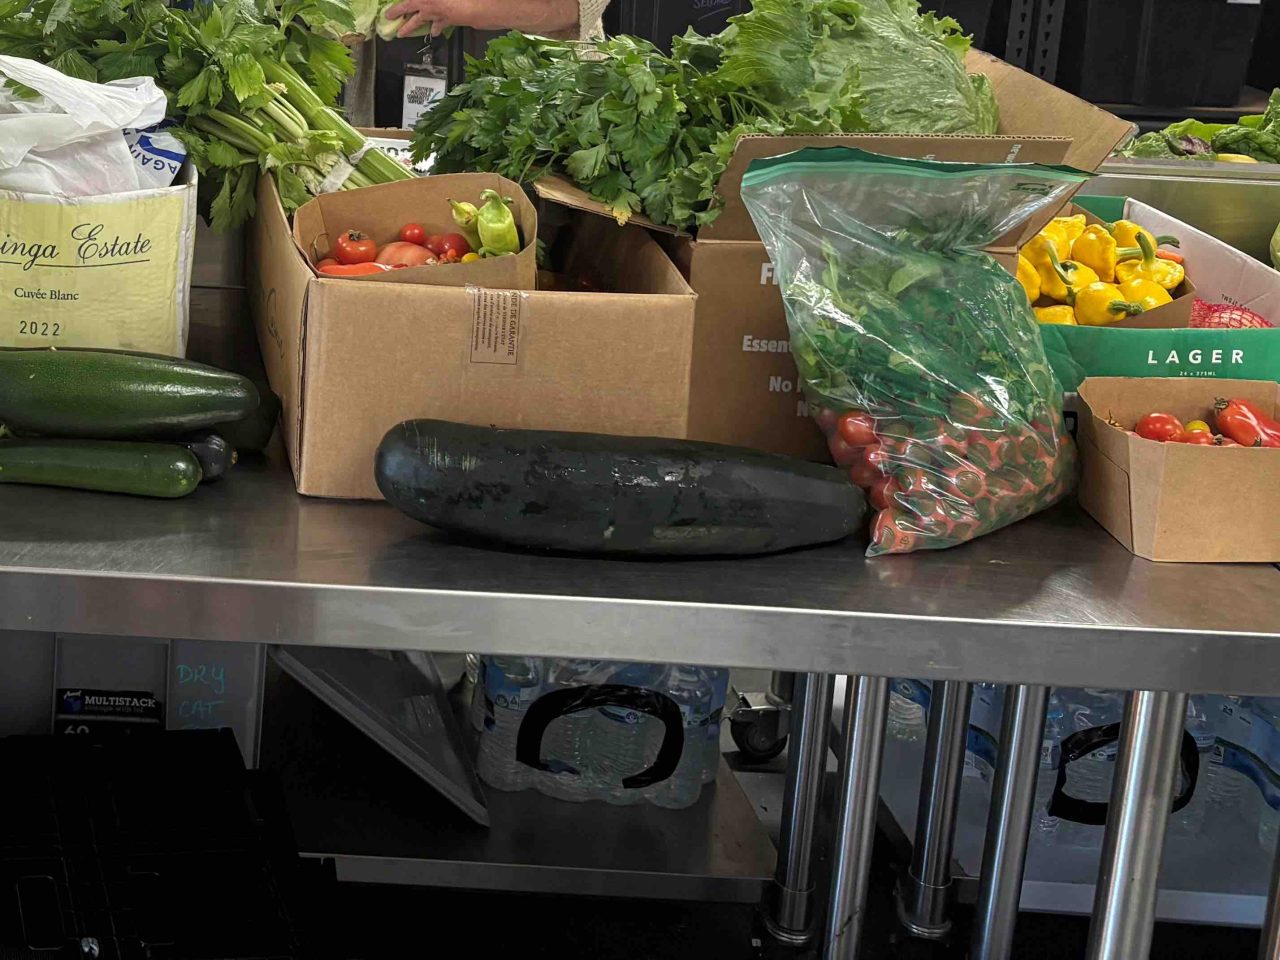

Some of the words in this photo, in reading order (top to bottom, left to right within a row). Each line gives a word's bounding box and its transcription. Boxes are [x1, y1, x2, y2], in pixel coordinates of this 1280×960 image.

[71, 223, 152, 264] Estate
[14, 287, 47, 301] Cuvée
[49, 289, 79, 301] Blanc
[510, 309, 517, 319] DE
[19, 320, 61, 336] 2022
[508, 320, 517, 356] GARANTIE
[1147, 349, 1244, 364] LAGER
[769, 376, 793, 392] No
[176, 664, 225, 694] DRY
[84, 695, 156, 708] MULTISTACK
[179, 699, 225, 718] CAT
